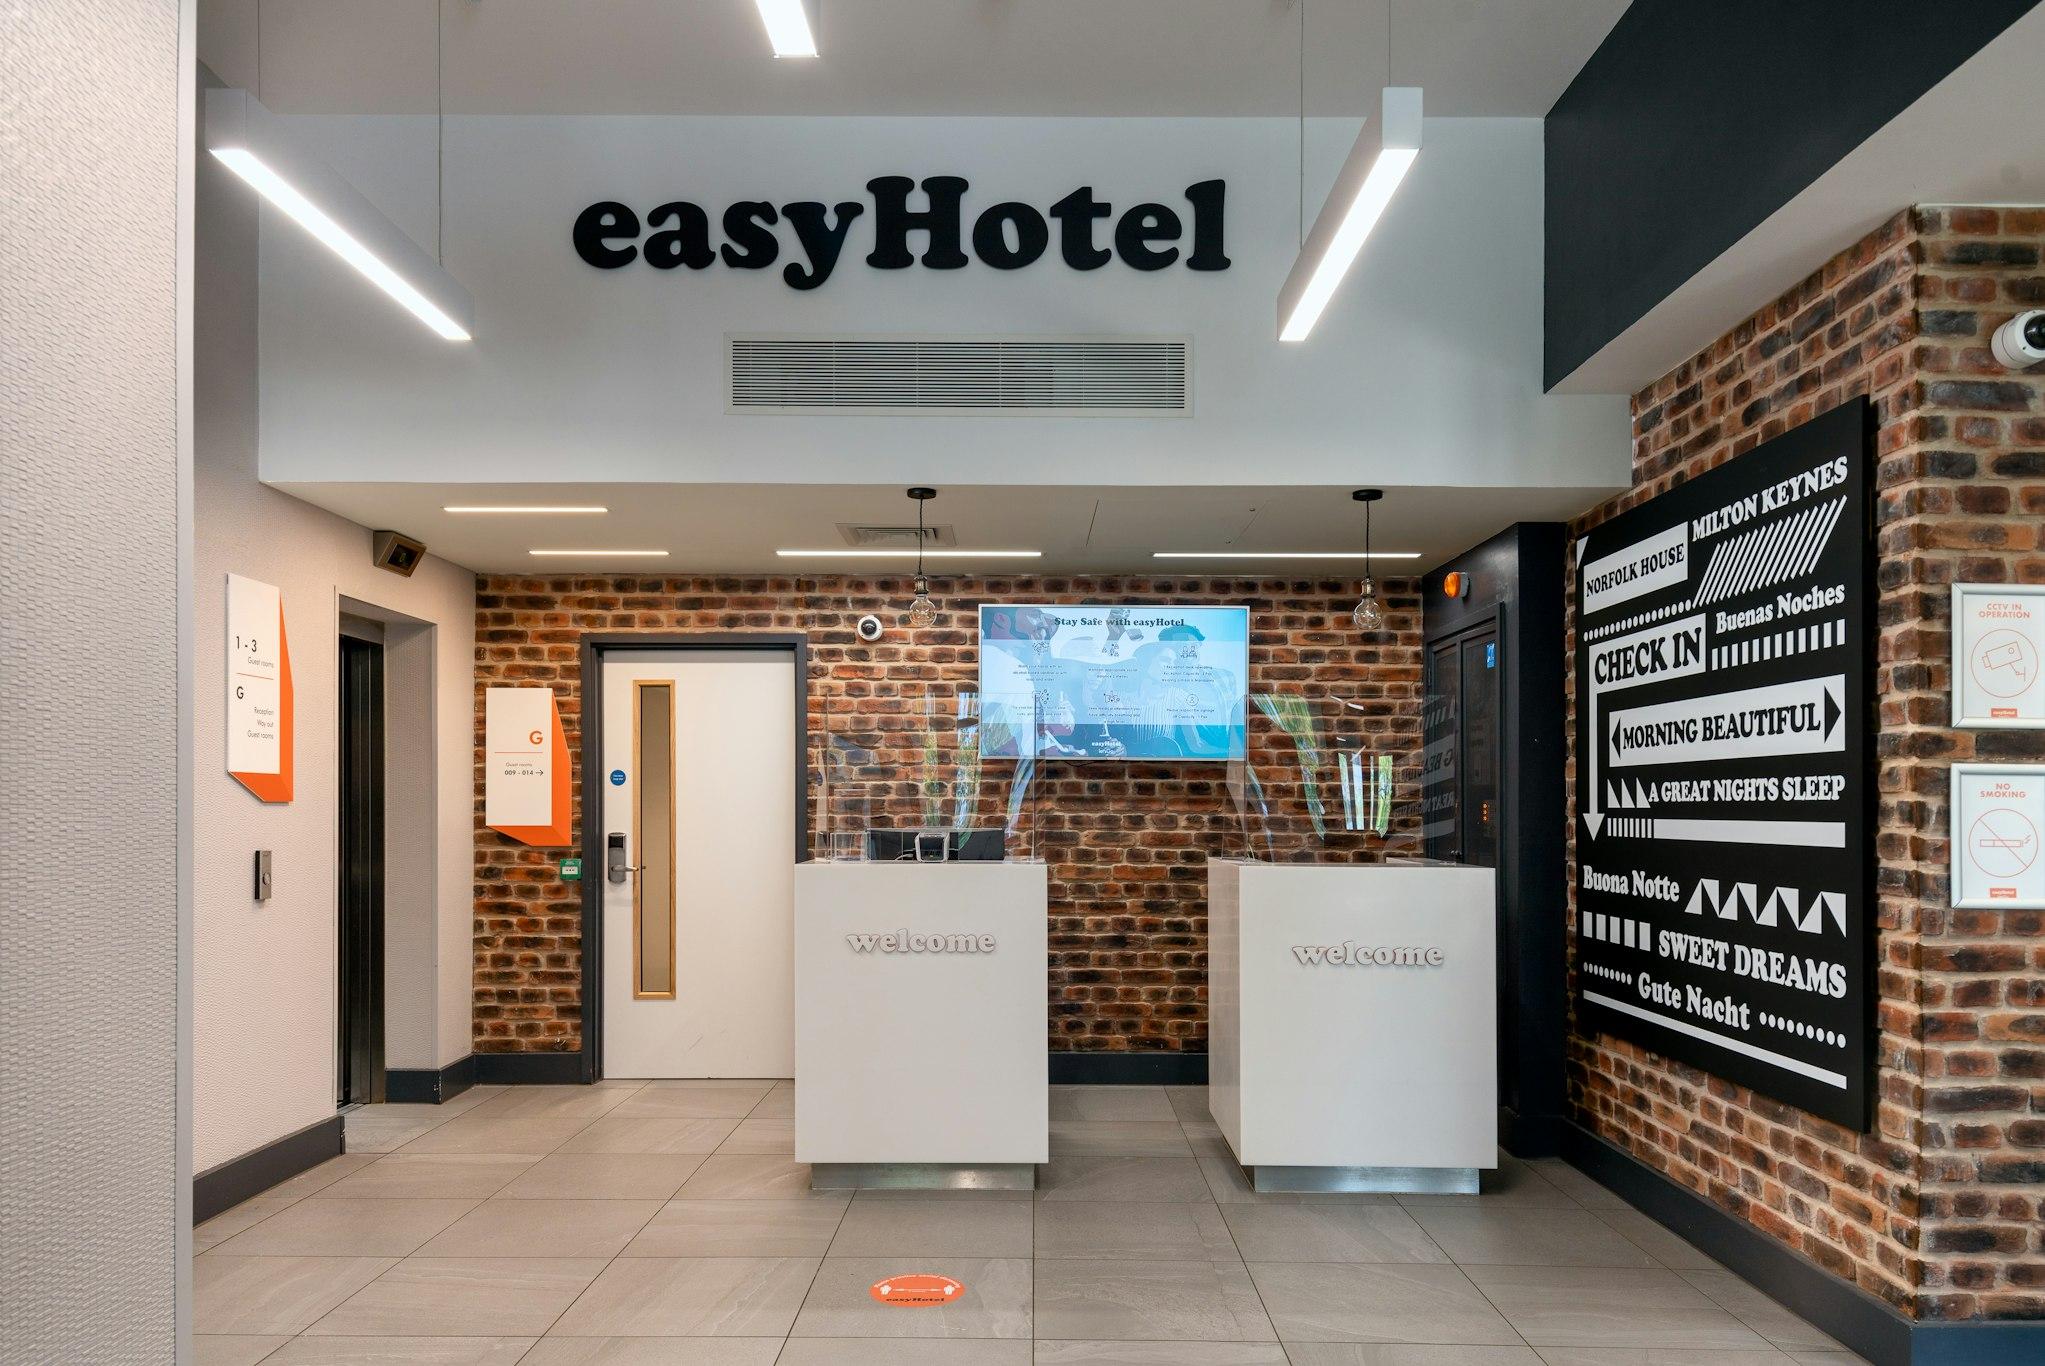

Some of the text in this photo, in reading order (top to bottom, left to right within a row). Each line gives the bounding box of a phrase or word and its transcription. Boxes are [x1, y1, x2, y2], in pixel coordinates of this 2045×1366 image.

[573, 175, 1231, 290] easyHotel
[1692, 456, 1848, 542] MILTON KEYNES
[1586, 543, 1684, 598] NORFOLK HOUSE
[1054, 617, 1185, 627] Stay Safe with easyHotel
[1715, 584, 1845, 635] Buenas Noches
[1978, 610, 2030, 619] OPERATION
[251, 639, 257, 652] 3
[1595, 627, 1701, 684] CHECK IN
[247, 656, 260, 666] Guest
[236, 686, 244, 700] G
[530, 731, 543, 745] G
[1622, 702, 1821, 750] MORNING BEAUTIFUL
[1649, 775, 1846, 803] A GREAT NIGHTS SLEEP
[1980, 790, 2026, 798] SMOKING
[1583, 865, 1680, 902] Buona Notte
[846, 928, 996, 953] welcome
[1292, 940, 1444, 966] welcome
[1658, 929, 1847, 998] SWEET DREAMS
[1638, 972, 1750, 1031] Gute Nacht
